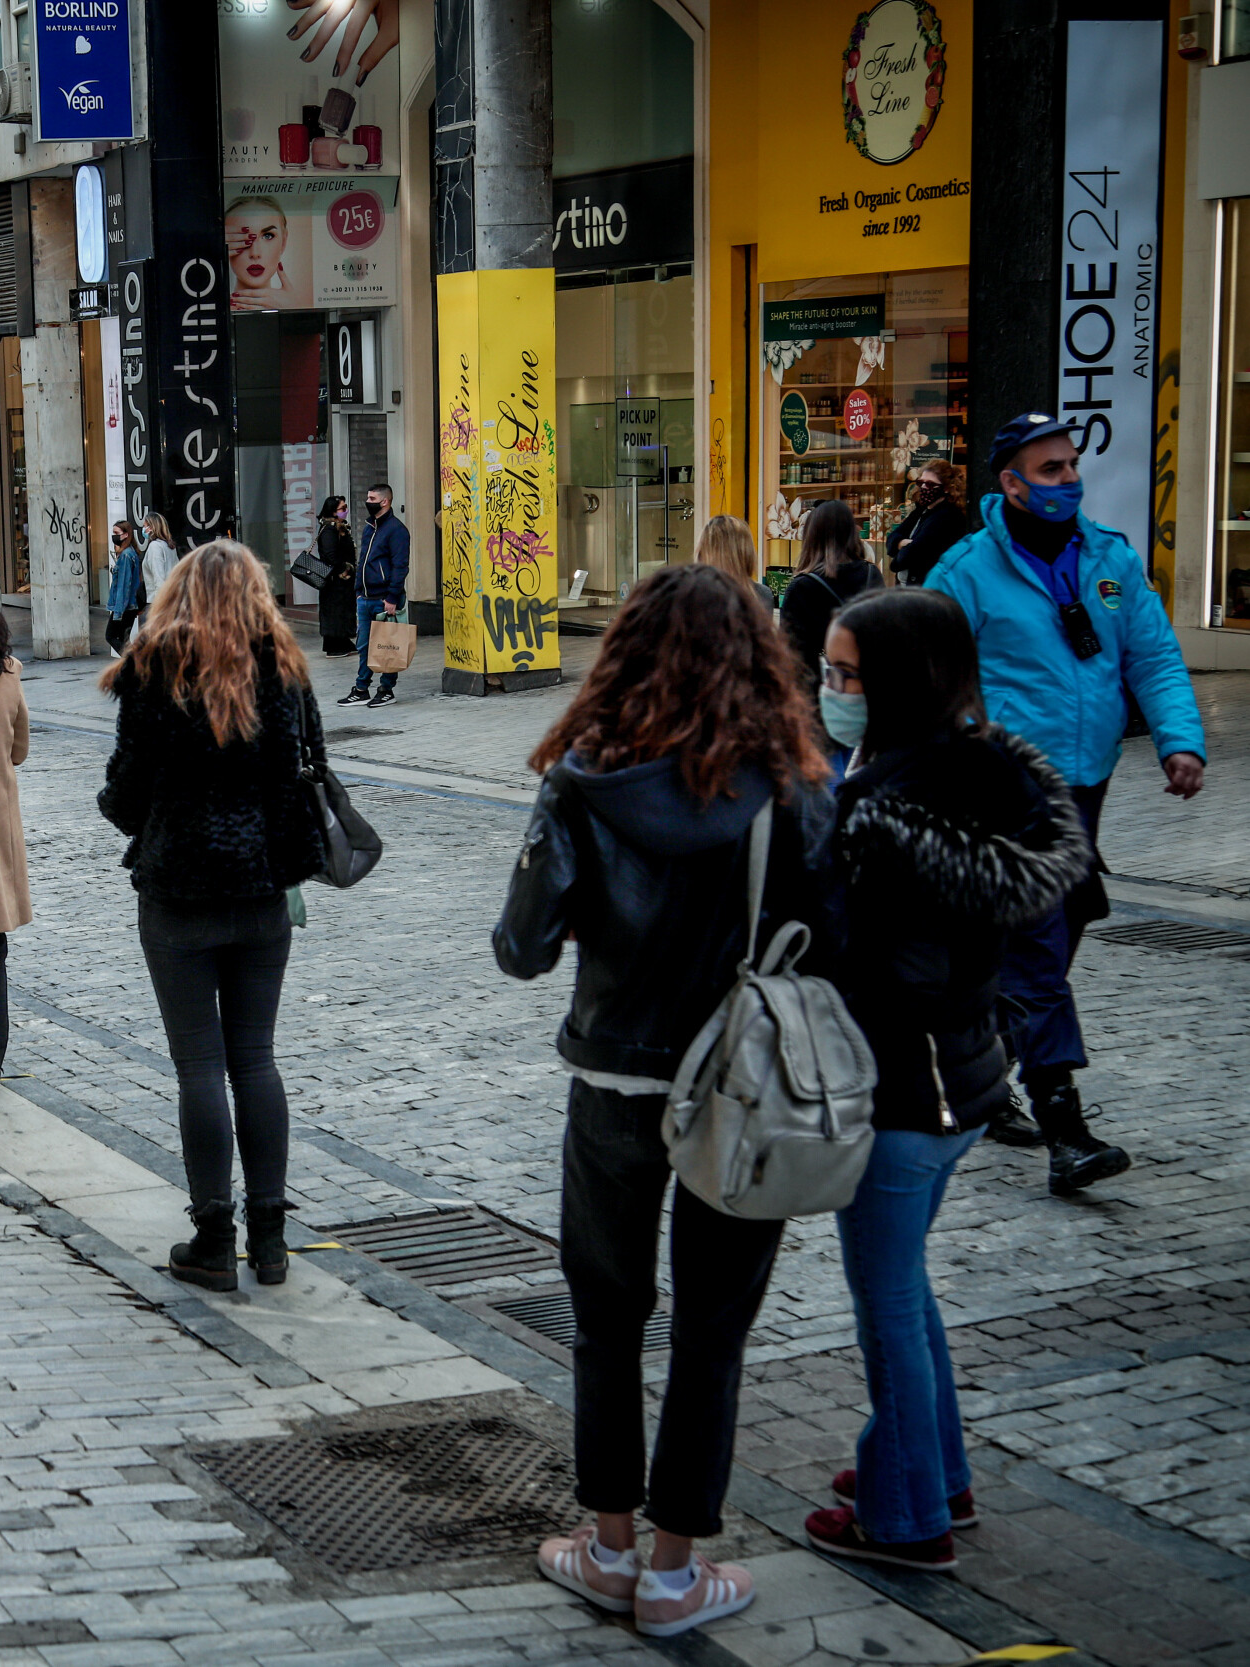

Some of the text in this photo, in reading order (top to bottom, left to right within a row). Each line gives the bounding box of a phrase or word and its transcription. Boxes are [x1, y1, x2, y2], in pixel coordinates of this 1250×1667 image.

[45, 1, 119, 18] BÖRLIND
[216, 0, 269, 13] ssie
[863, 42, 918, 81] Fresh
[58, 79, 104, 114] Vegan
[867, 80, 910, 117] Line
[241, 180, 355, 194] MANICURE PEDICURE
[819, 178, 970, 214] Fresh Organic Cosmetics
[108, 193, 122, 208] HAIR
[339, 205, 375, 235] 25€
[552, 196, 627, 251] stino
[862, 214, 920, 238] since 1992
[108, 229, 124, 244] NAILS
[770, 306, 878, 320] SHAPE THE FUTURE OF YOUR SKIN
[1063, 166, 1120, 456] SHOE24
[1133, 243, 1153, 379] ANATOMIC
[789, 322, 808, 331] Miracle
[836, 320, 857, 329] booster
[123, 271, 149, 553] celestino
[497, 349, 539, 455] Line
[849, 397, 867, 408] Sales
[620, 409, 656, 424] PICK UP
[849, 413, 871, 431] 50%
[623, 433, 652, 447] POINT
